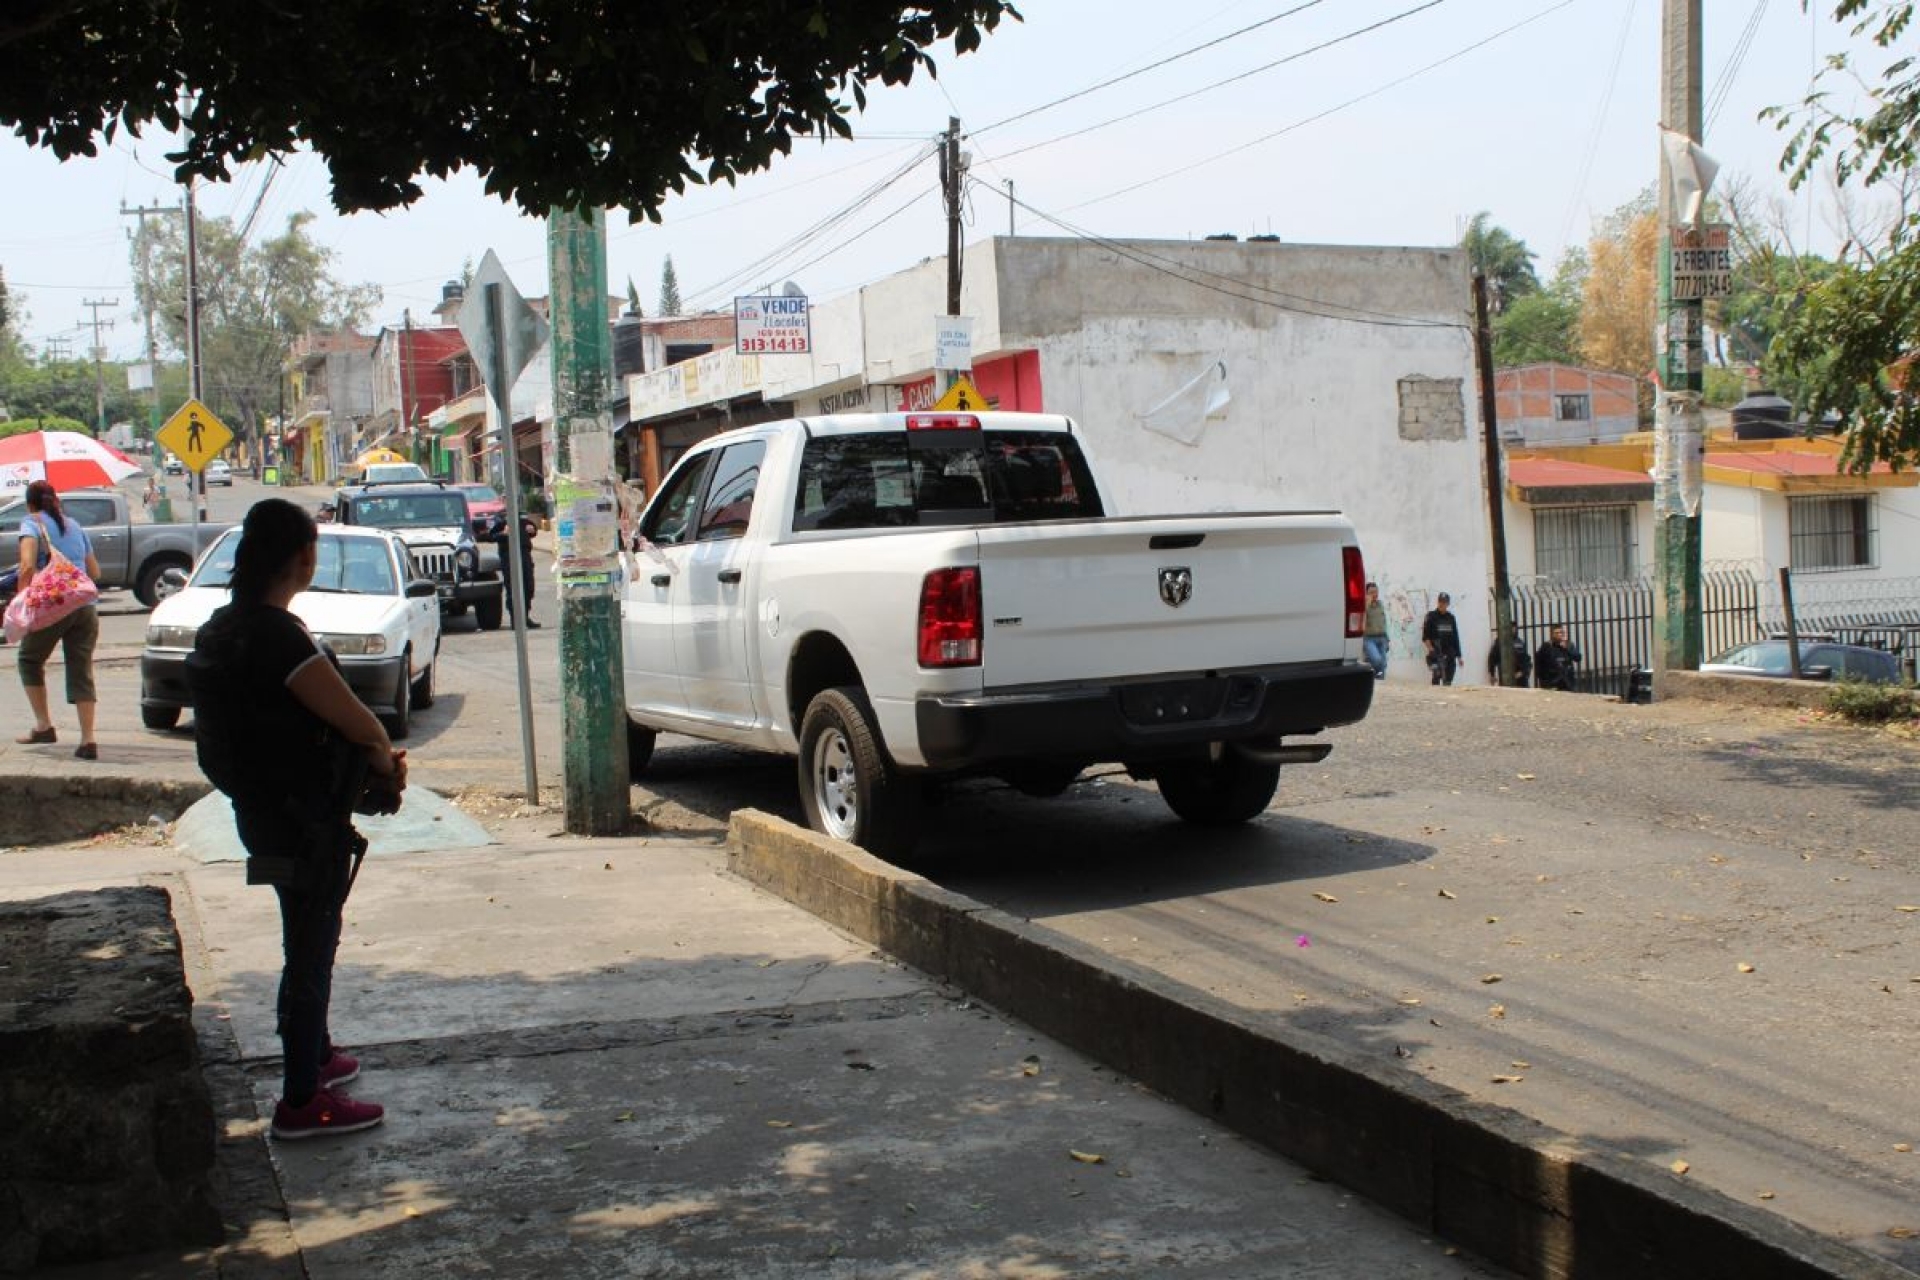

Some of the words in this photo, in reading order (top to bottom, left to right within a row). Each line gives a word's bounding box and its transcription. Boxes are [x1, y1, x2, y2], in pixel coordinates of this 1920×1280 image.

[1674, 252, 1681, 271] 2
[1684, 250, 1730, 270] FRENTES
[761, 300, 806, 314] VENDE
